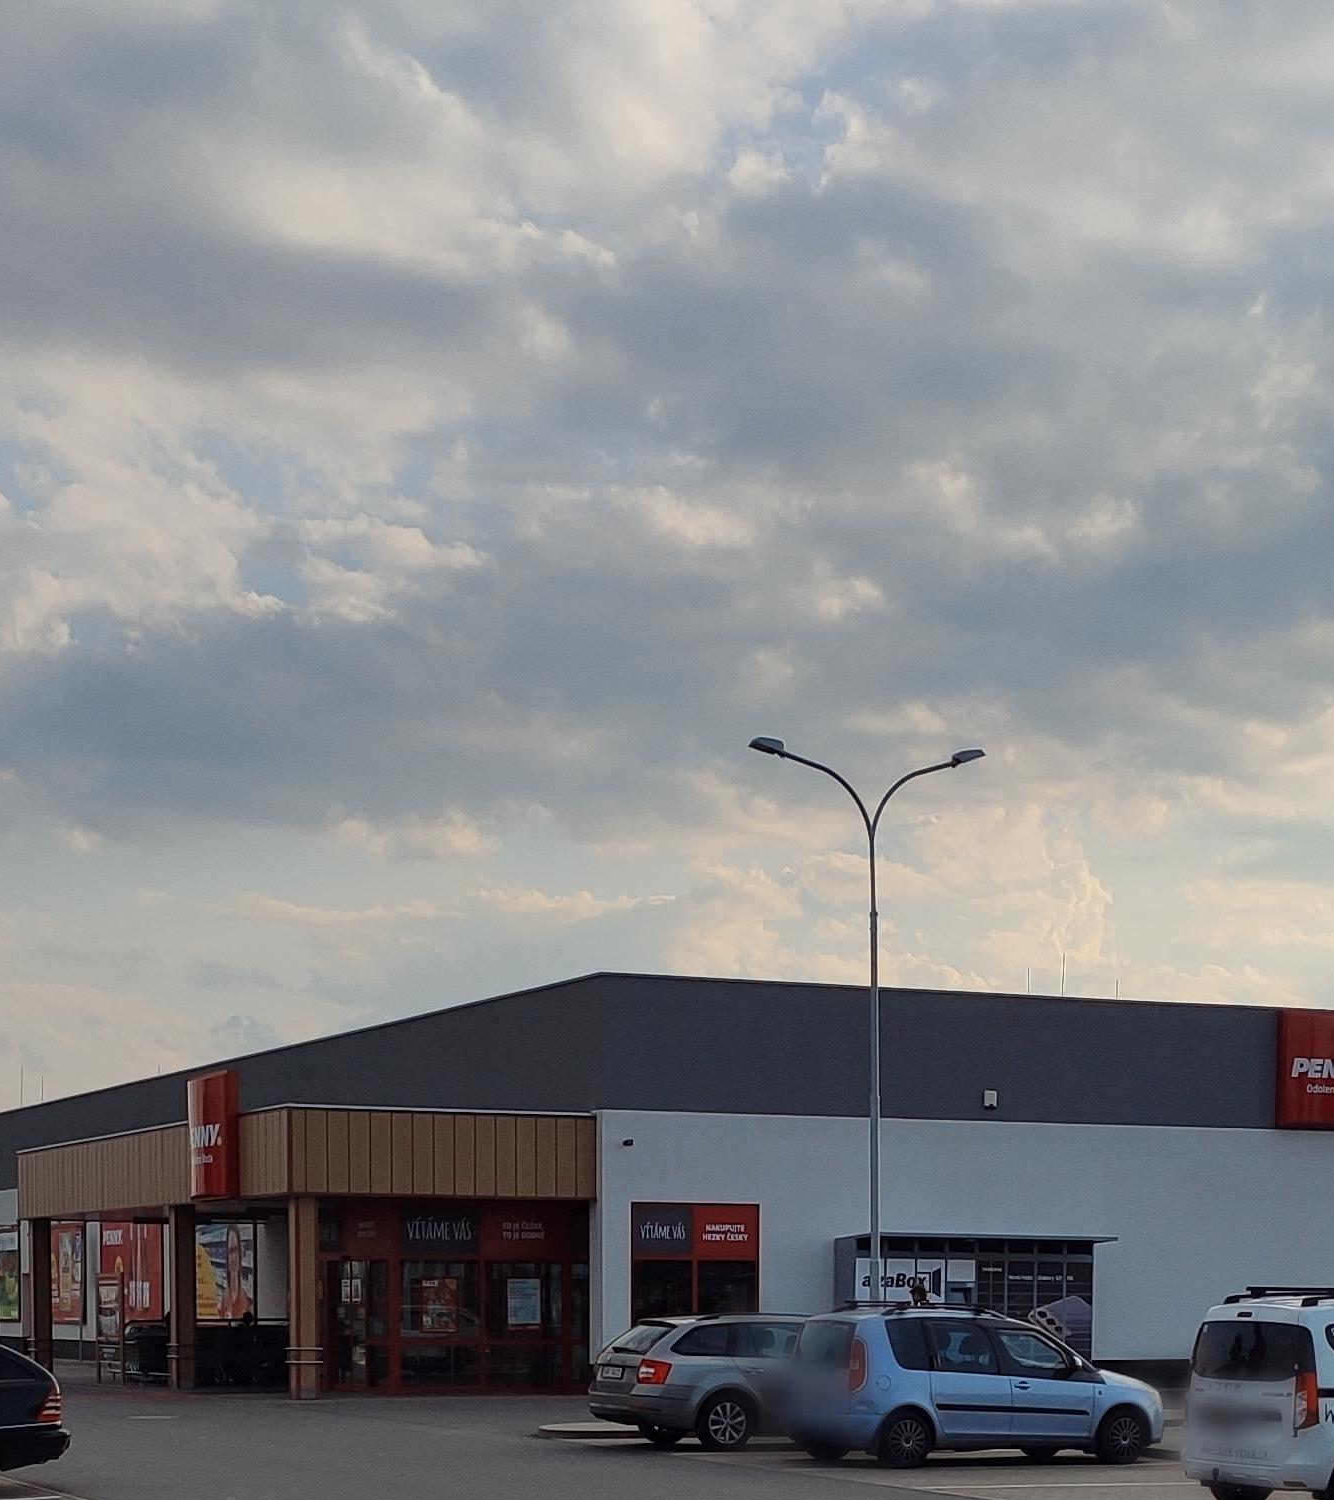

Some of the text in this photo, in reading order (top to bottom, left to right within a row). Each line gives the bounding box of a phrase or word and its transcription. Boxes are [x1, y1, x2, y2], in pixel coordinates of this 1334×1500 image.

[406, 1216, 473, 1241] VÍTÁME VÁS
[640, 1221, 686, 1240] VÍTÁME VÁS
